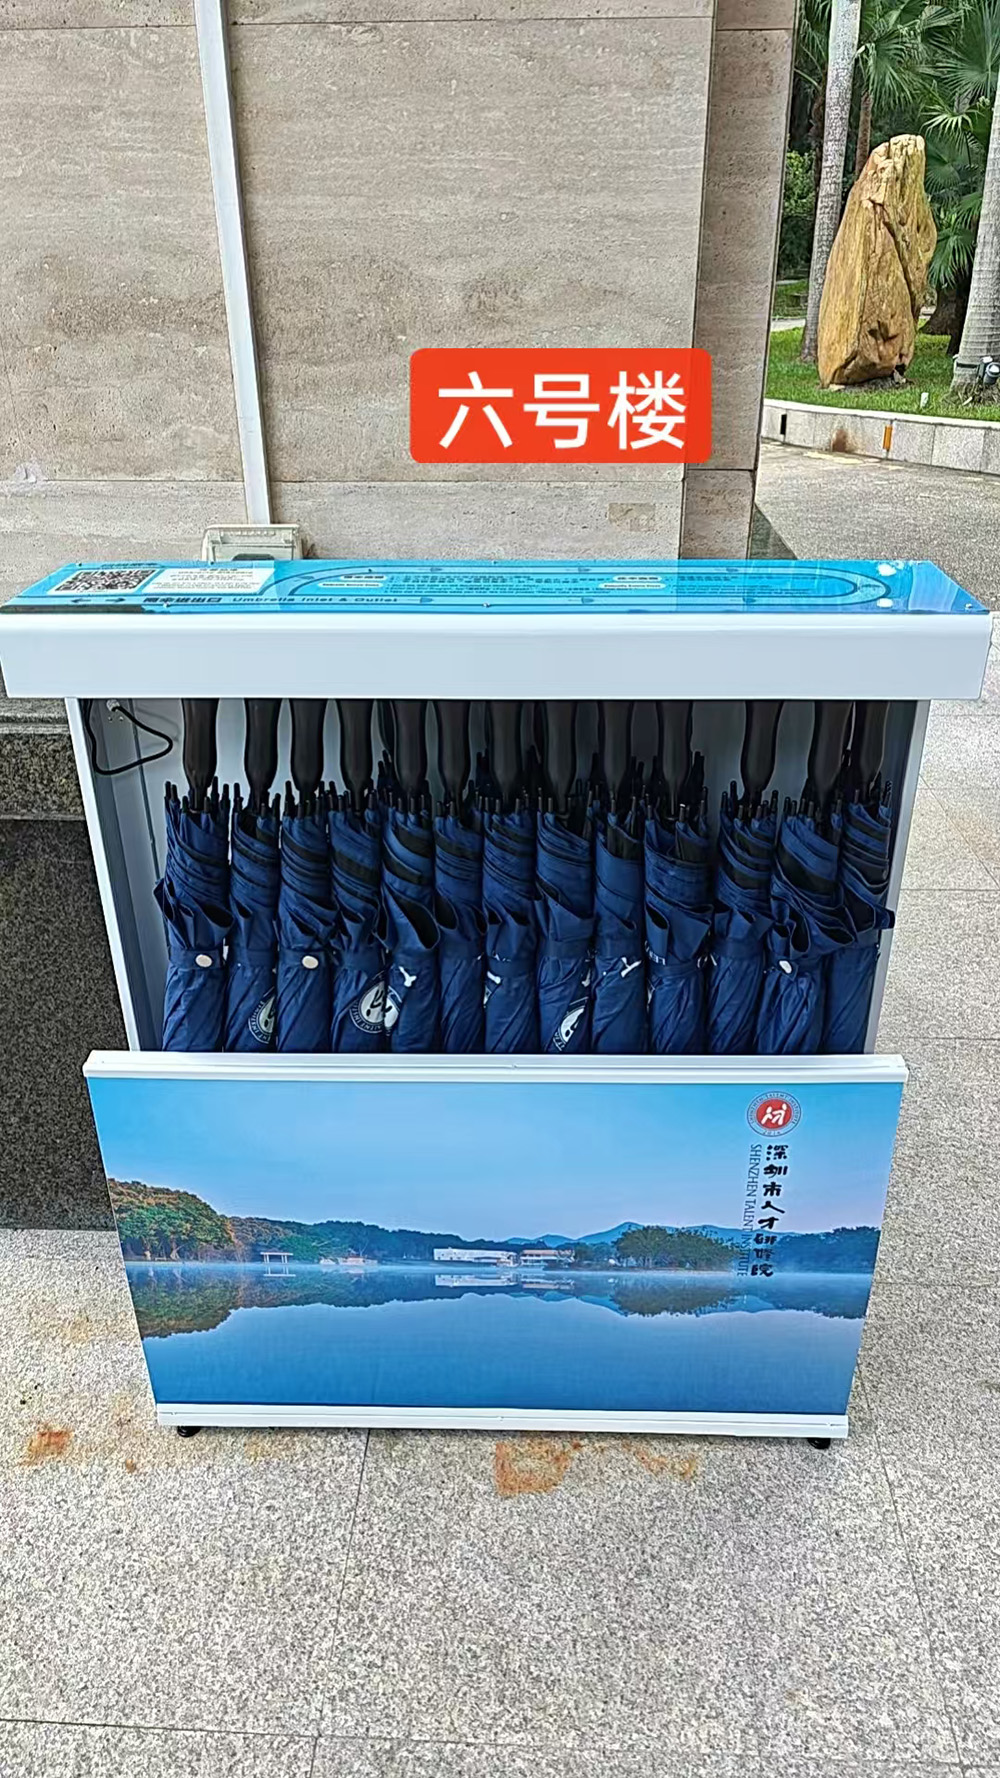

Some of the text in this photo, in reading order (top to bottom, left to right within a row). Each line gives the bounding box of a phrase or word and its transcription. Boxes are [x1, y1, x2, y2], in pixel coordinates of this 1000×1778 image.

[736, 1144, 762, 1277] SHENZHEN TALENT INSTITUTE
